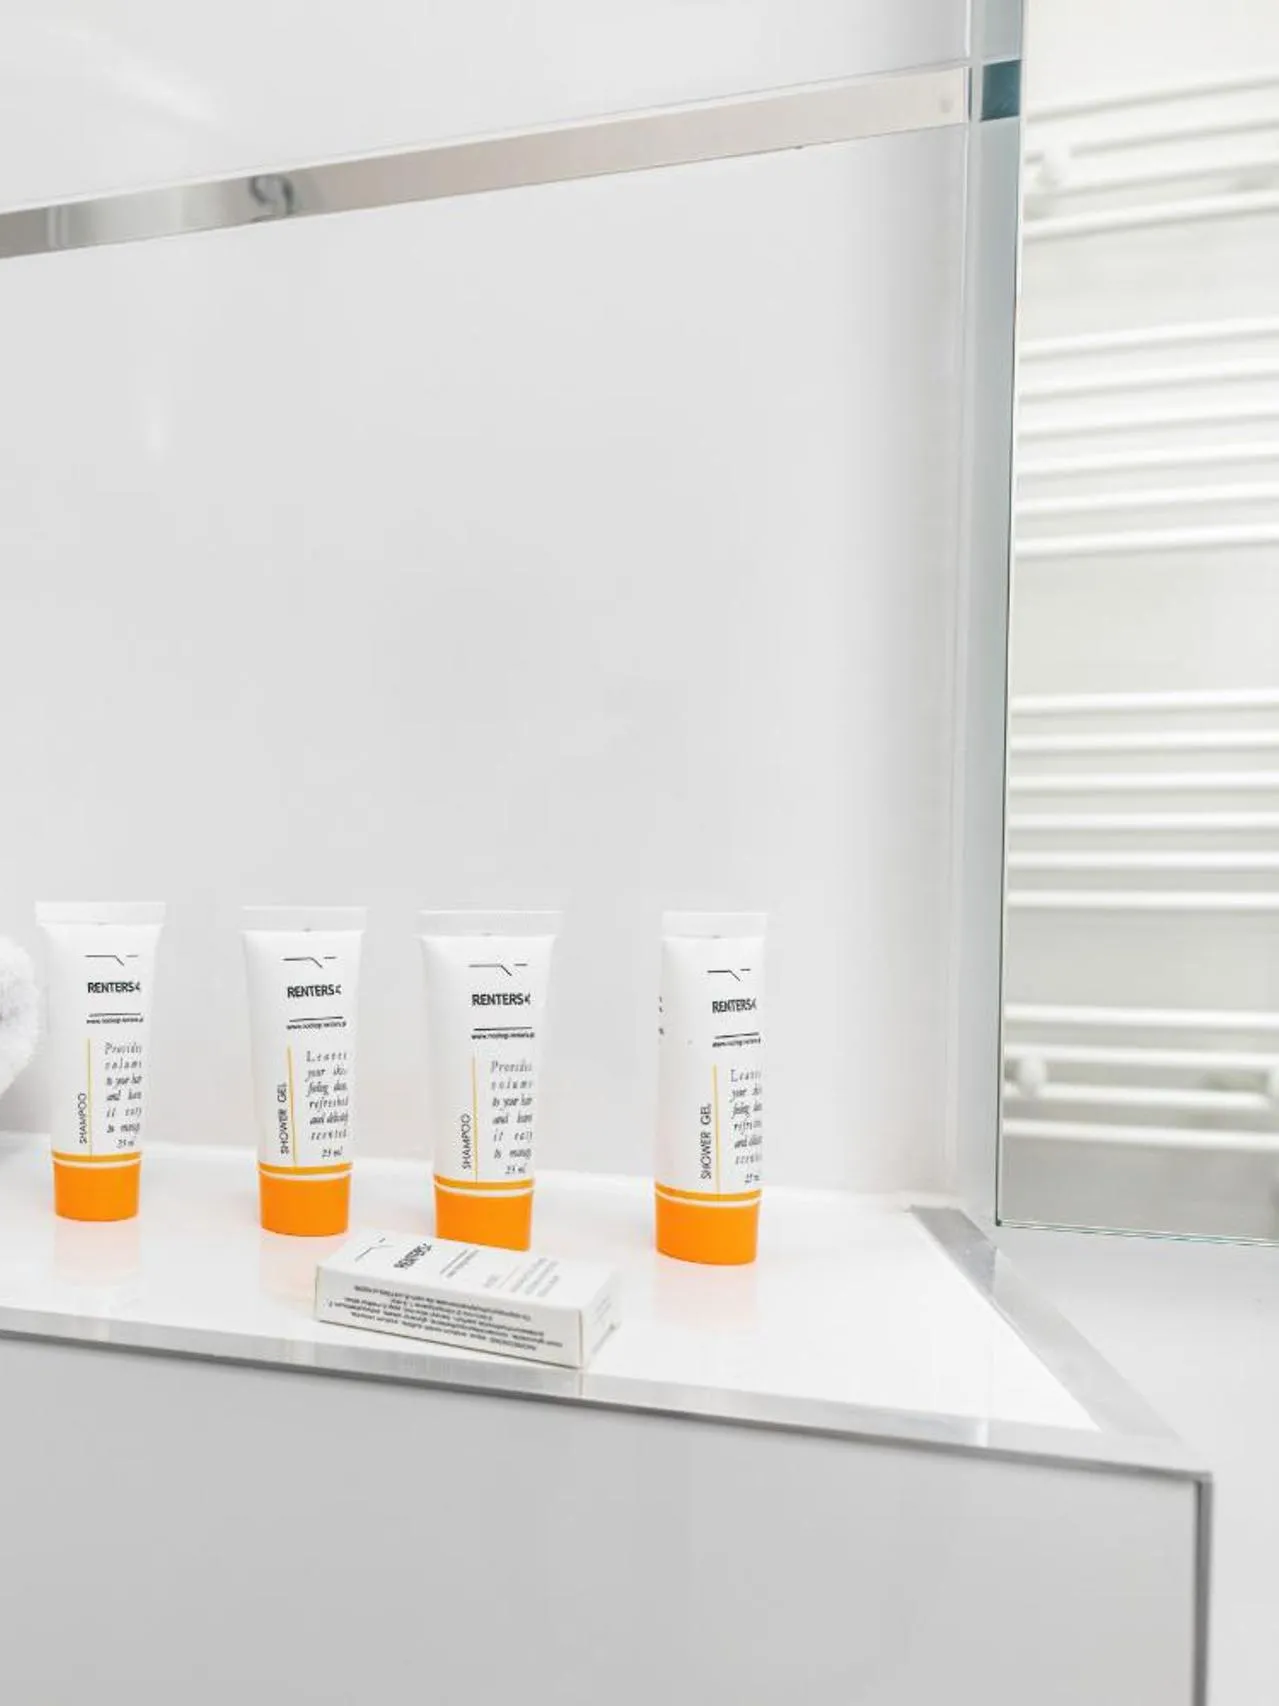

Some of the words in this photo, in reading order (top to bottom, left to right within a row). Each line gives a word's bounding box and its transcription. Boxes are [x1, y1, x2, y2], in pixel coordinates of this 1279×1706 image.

[87, 981, 135, 993] RENTERS
[287, 984, 335, 998] RENTERS
[471, 993, 524, 1006] RENTERS
[712, 998, 752, 1013] RENTERS
[276, 1081, 287, 1103] GEL
[77, 1092, 88, 1145] SHAMPOO
[699, 1103, 712, 1126] GEL
[278, 1109, 289, 1155] SHOWER
[460, 1112, 471, 1170] SHAMPOO
[699, 1131, 712, 1180] SHOWER
